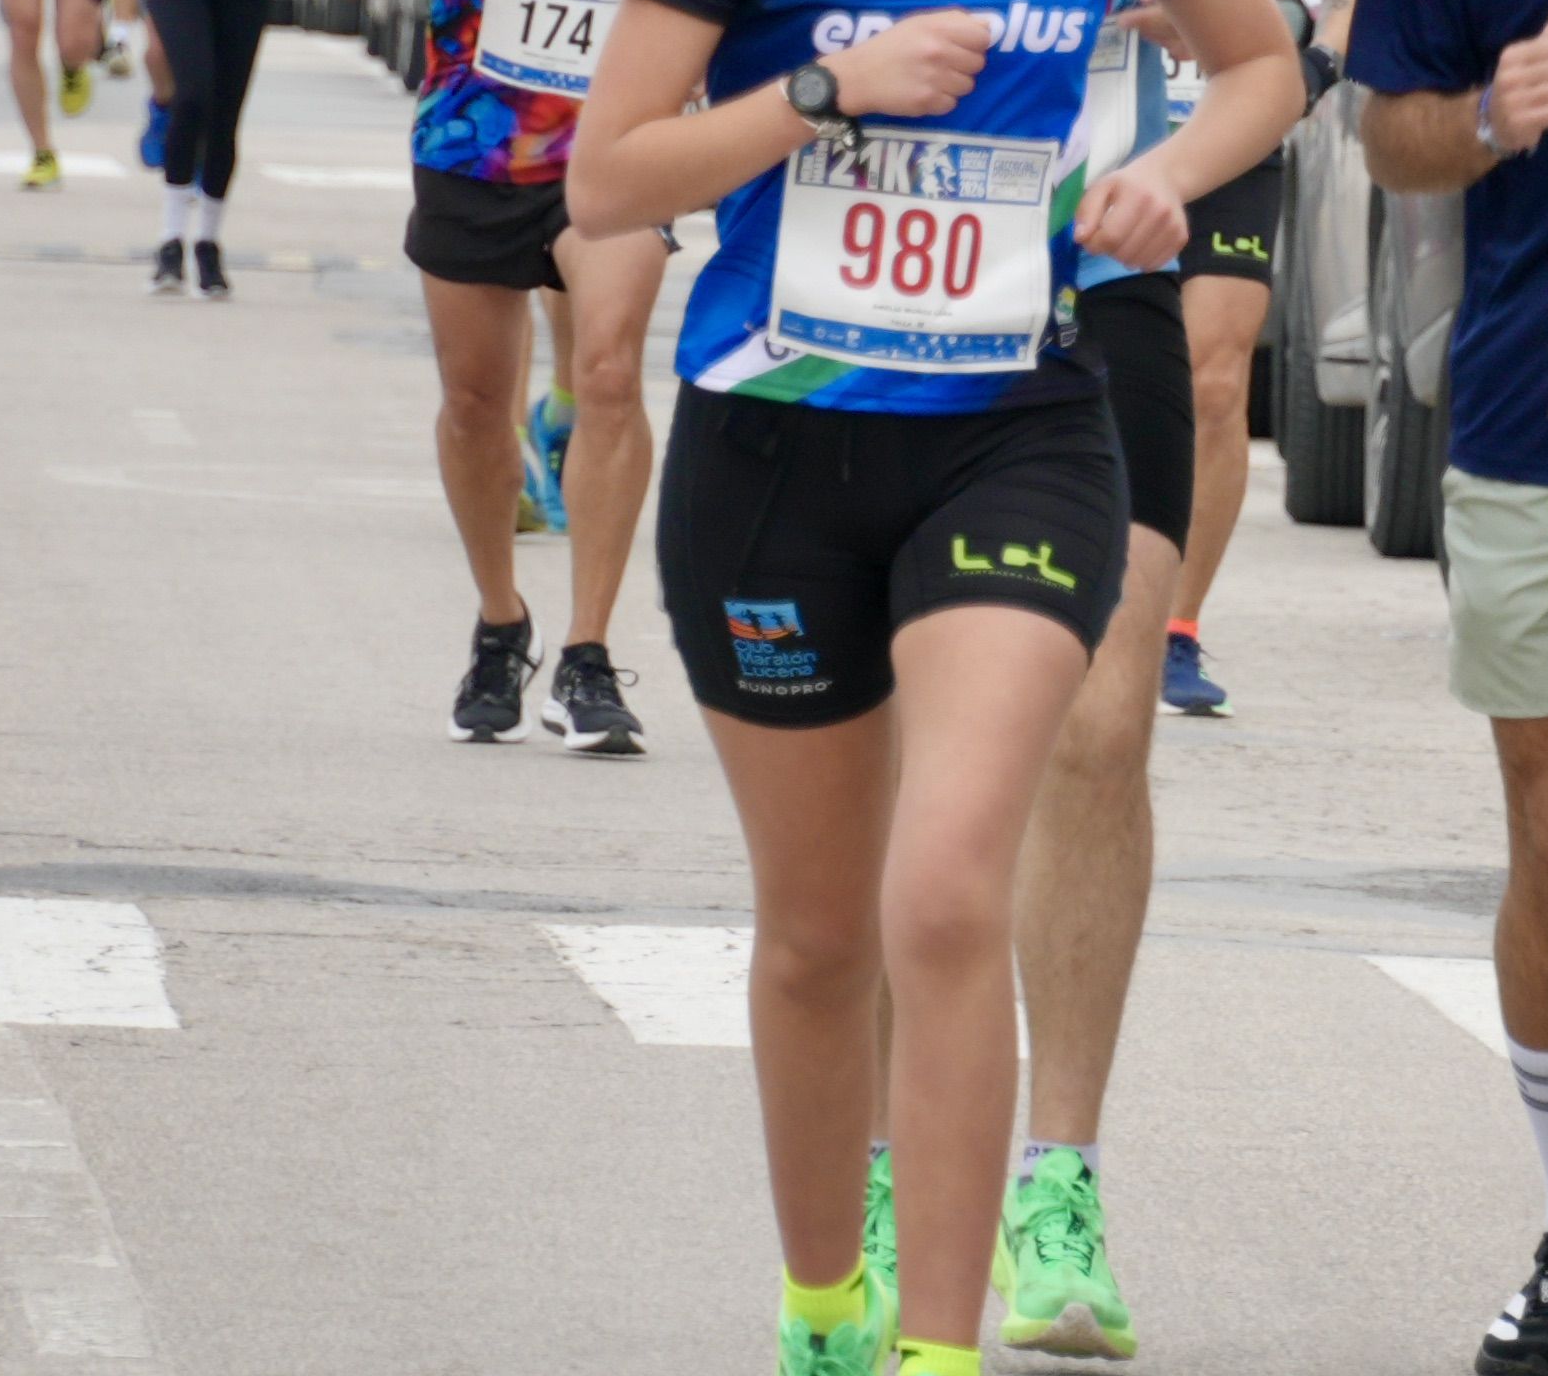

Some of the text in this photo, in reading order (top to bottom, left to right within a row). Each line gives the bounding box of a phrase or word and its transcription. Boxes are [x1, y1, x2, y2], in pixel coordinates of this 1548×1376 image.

[518, 0, 595, 56] 174
[839, 201, 983, 301] 980
[734, 639, 774, 655] Club
[738, 649, 818, 667] Maratón
[741, 664, 814, 679] Lucena
